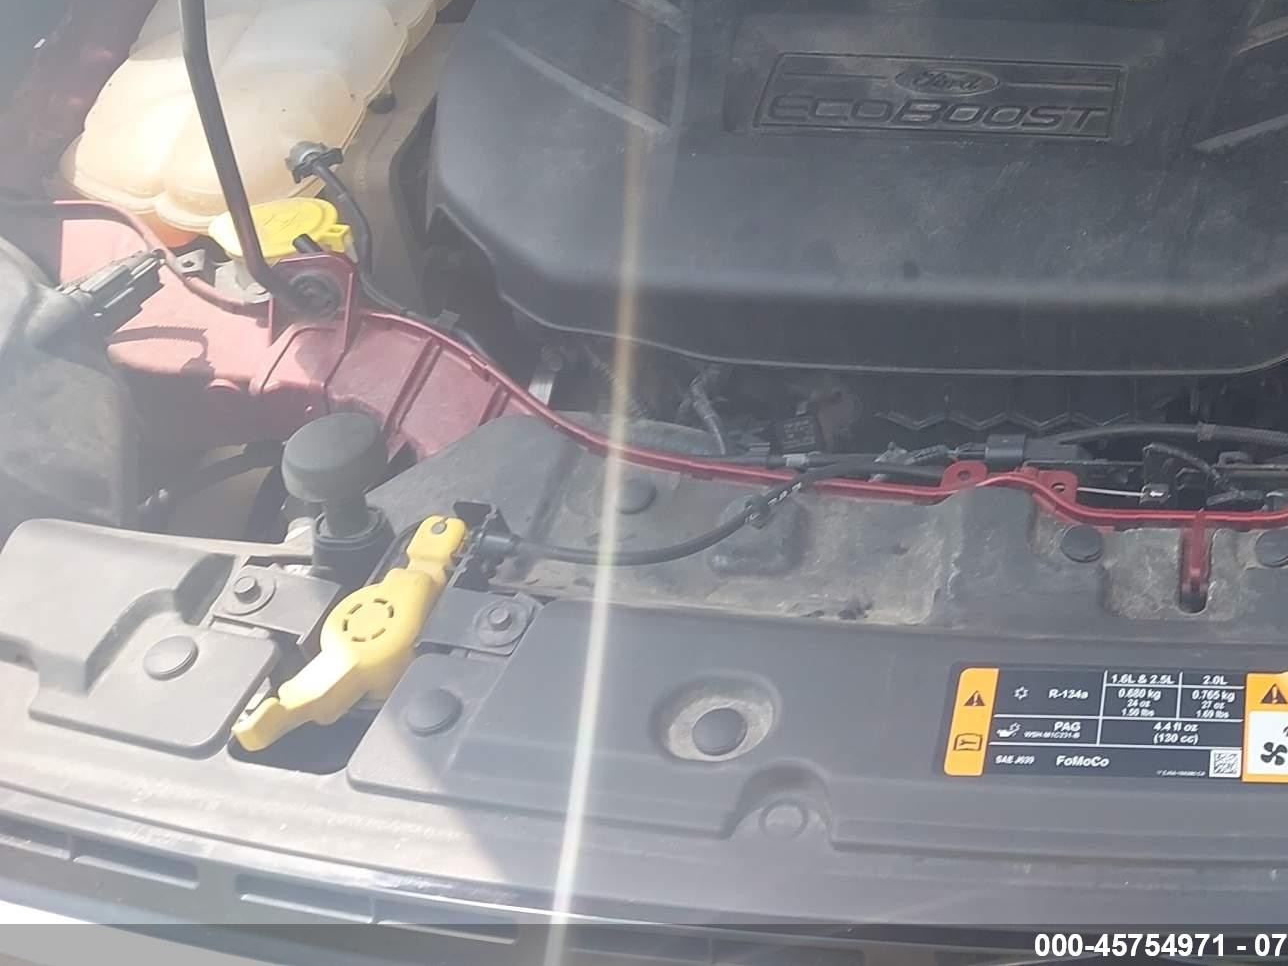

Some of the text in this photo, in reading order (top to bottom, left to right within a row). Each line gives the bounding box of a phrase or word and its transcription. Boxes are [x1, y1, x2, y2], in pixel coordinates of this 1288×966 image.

[1111, 674, 1177, 685] 1.6L & 2.5L
[1202, 675, 1229, 686] 2.0L
[1048, 688, 1089, 699] R-134a
[1147, 689, 1162, 701] kg
[1191, 690, 1236, 703] 0.765 kg
[1127, 699, 1139, 708] 24
[1201, 701, 1226, 710] 27 oz
[1054, 721, 1081, 732] PAG
[1153, 722, 1172, 732] 4.4
[1183, 724, 1199, 732] oz
[1180, 733, 1199, 746] cc)
[1056, 755, 1110, 768] FoMoCo
